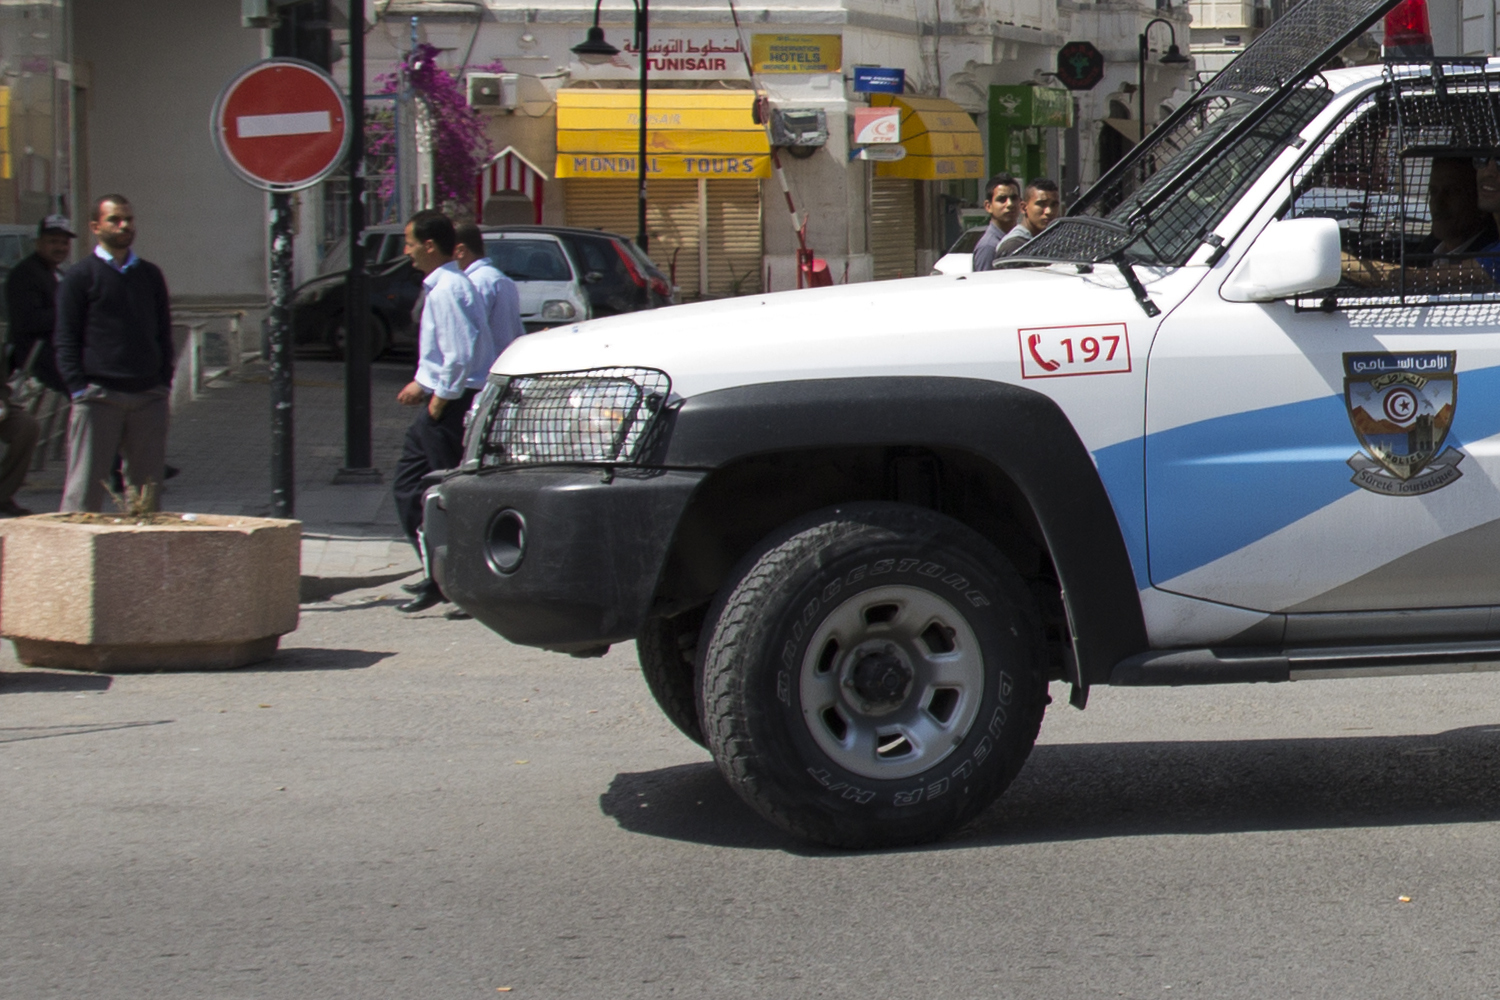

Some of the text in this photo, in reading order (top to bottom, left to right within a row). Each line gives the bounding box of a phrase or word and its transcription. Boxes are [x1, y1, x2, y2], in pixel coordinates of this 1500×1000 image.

[646, 58, 726, 71] TUNISAIR
[769, 52, 820, 63] HOTELS
[628, 114, 681, 125] TUISAIR
[683, 157, 754, 173] TOURS
[1060, 335, 1120, 363] 197
[1385, 451, 1424, 465] POLICE
[1359, 469, 1454, 492] Sûreté Touristique
[777, 558, 990, 707] BRIDGESTONE
[893, 670, 1014, 807] DUELER
